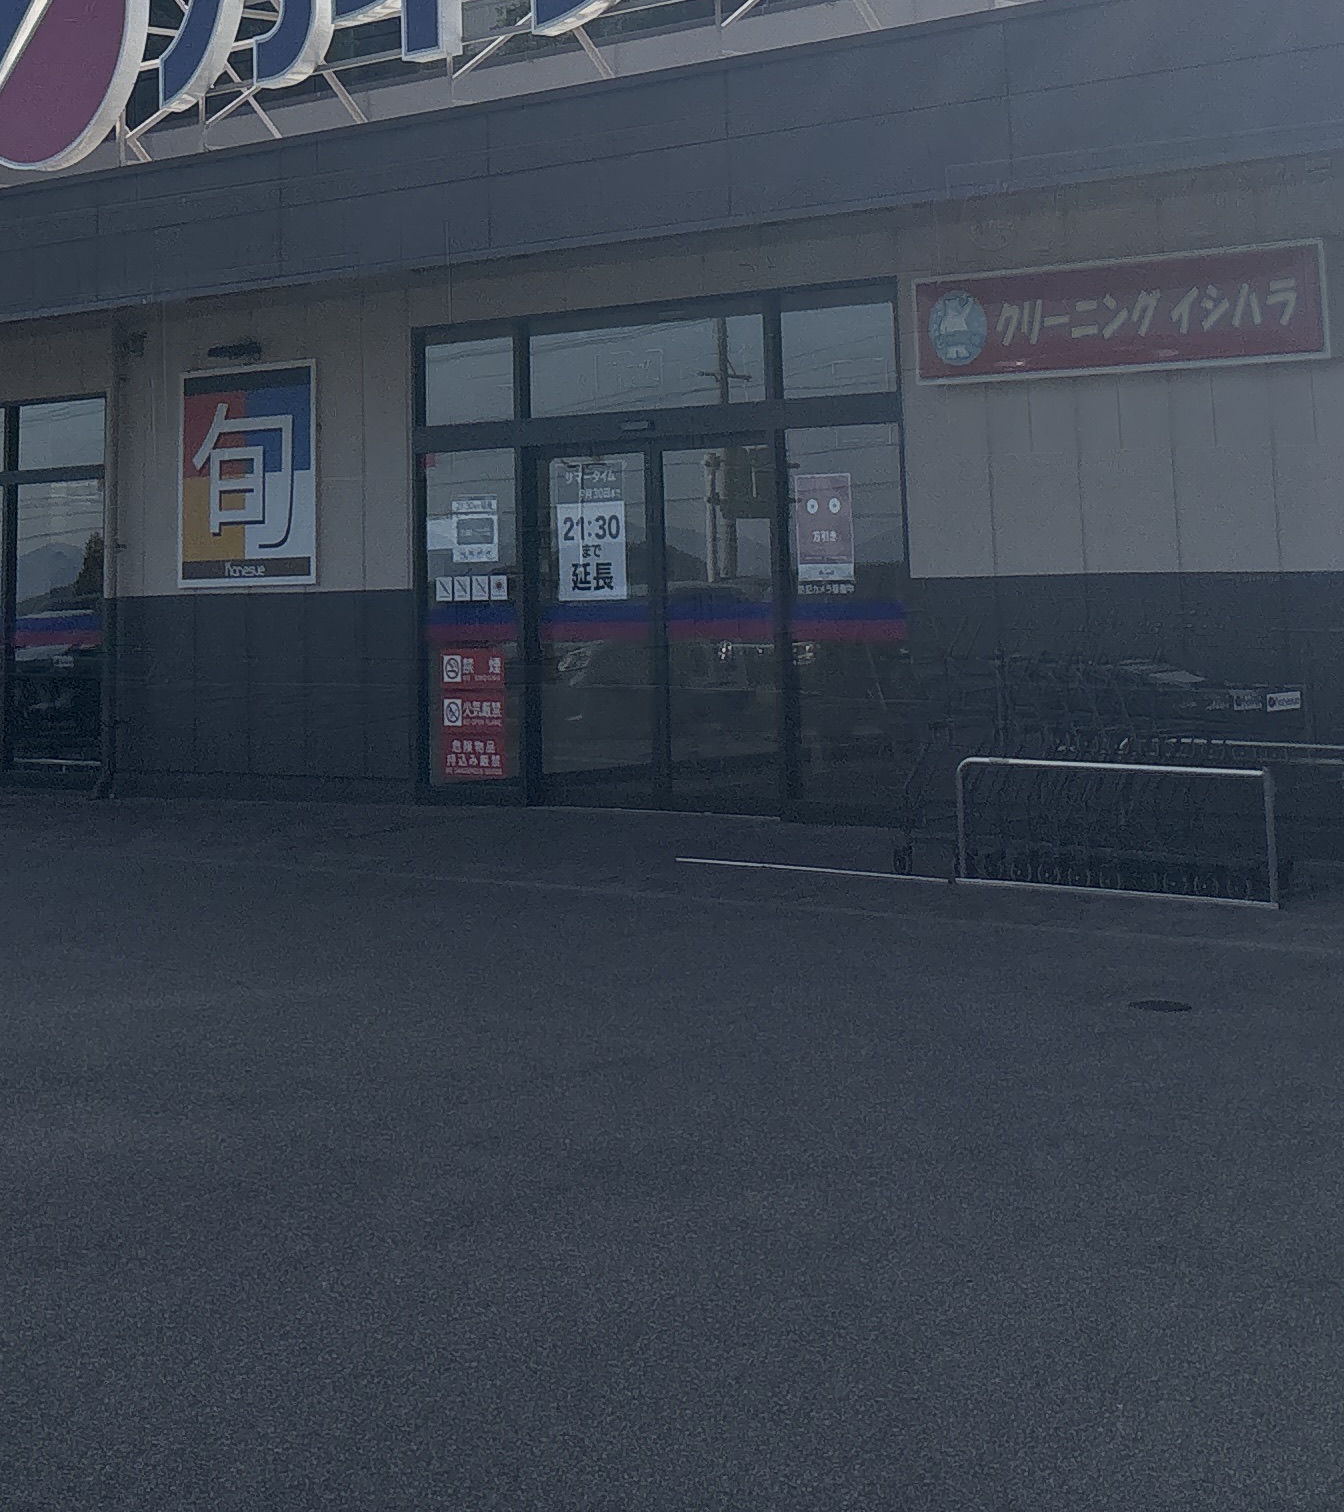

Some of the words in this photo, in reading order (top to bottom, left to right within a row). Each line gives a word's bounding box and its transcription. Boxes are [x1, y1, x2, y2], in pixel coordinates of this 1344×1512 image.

[995, 289, 1161, 346] クリーニング
[1170, 276, 1298, 334] イシハラ
[192, 402, 294, 549] 旬
[562, 514, 621, 542] 21:30
[581, 544, 603, 558] まで
[571, 562, 615, 591] 延長
